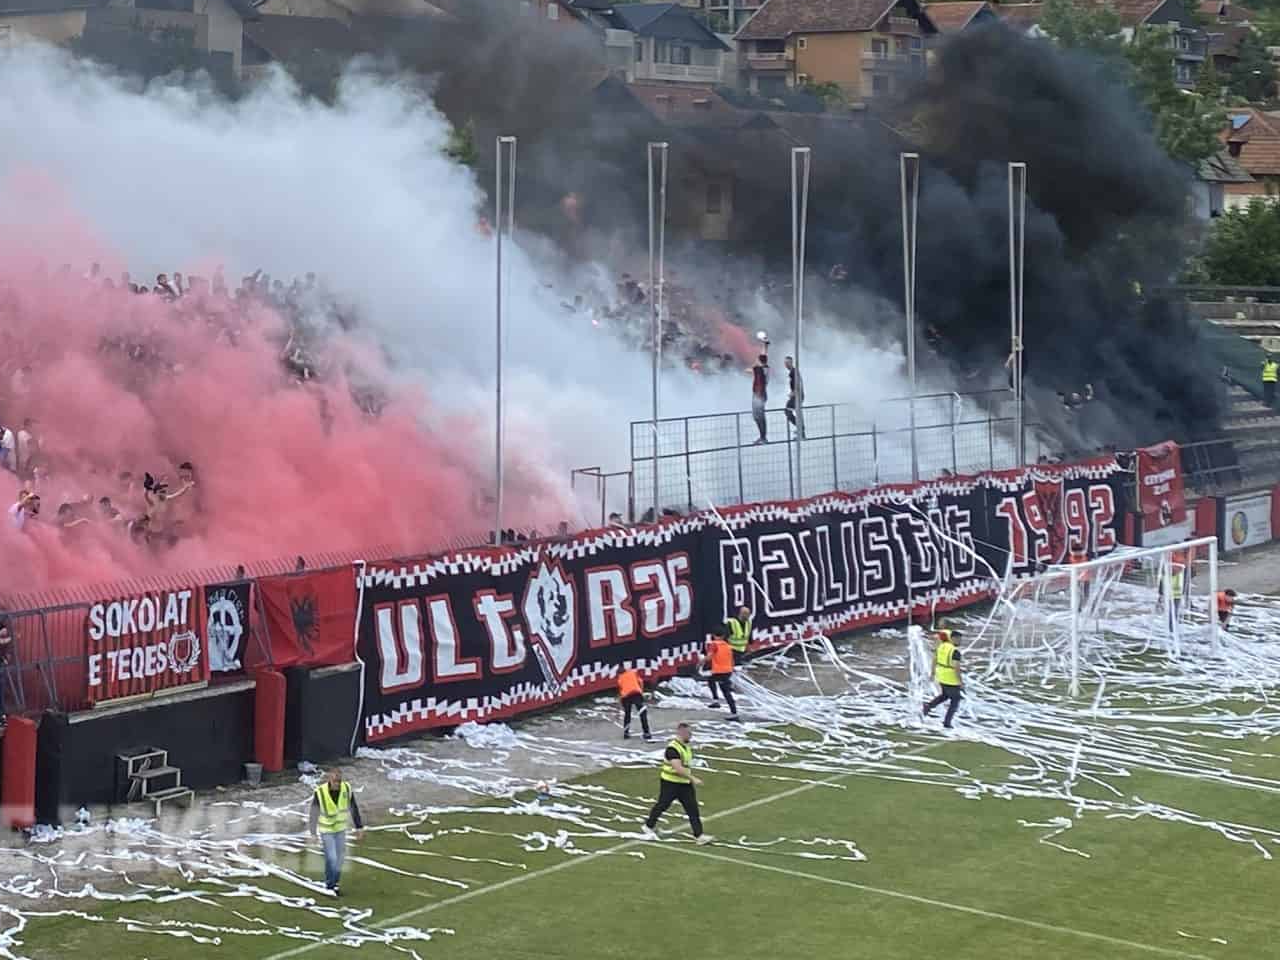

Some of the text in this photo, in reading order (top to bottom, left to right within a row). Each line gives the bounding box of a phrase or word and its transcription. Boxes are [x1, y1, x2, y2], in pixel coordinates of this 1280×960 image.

[995, 484, 1117, 568] 1992
[88, 590, 192, 641] SOKOLAT
[88, 653, 102, 687] E
